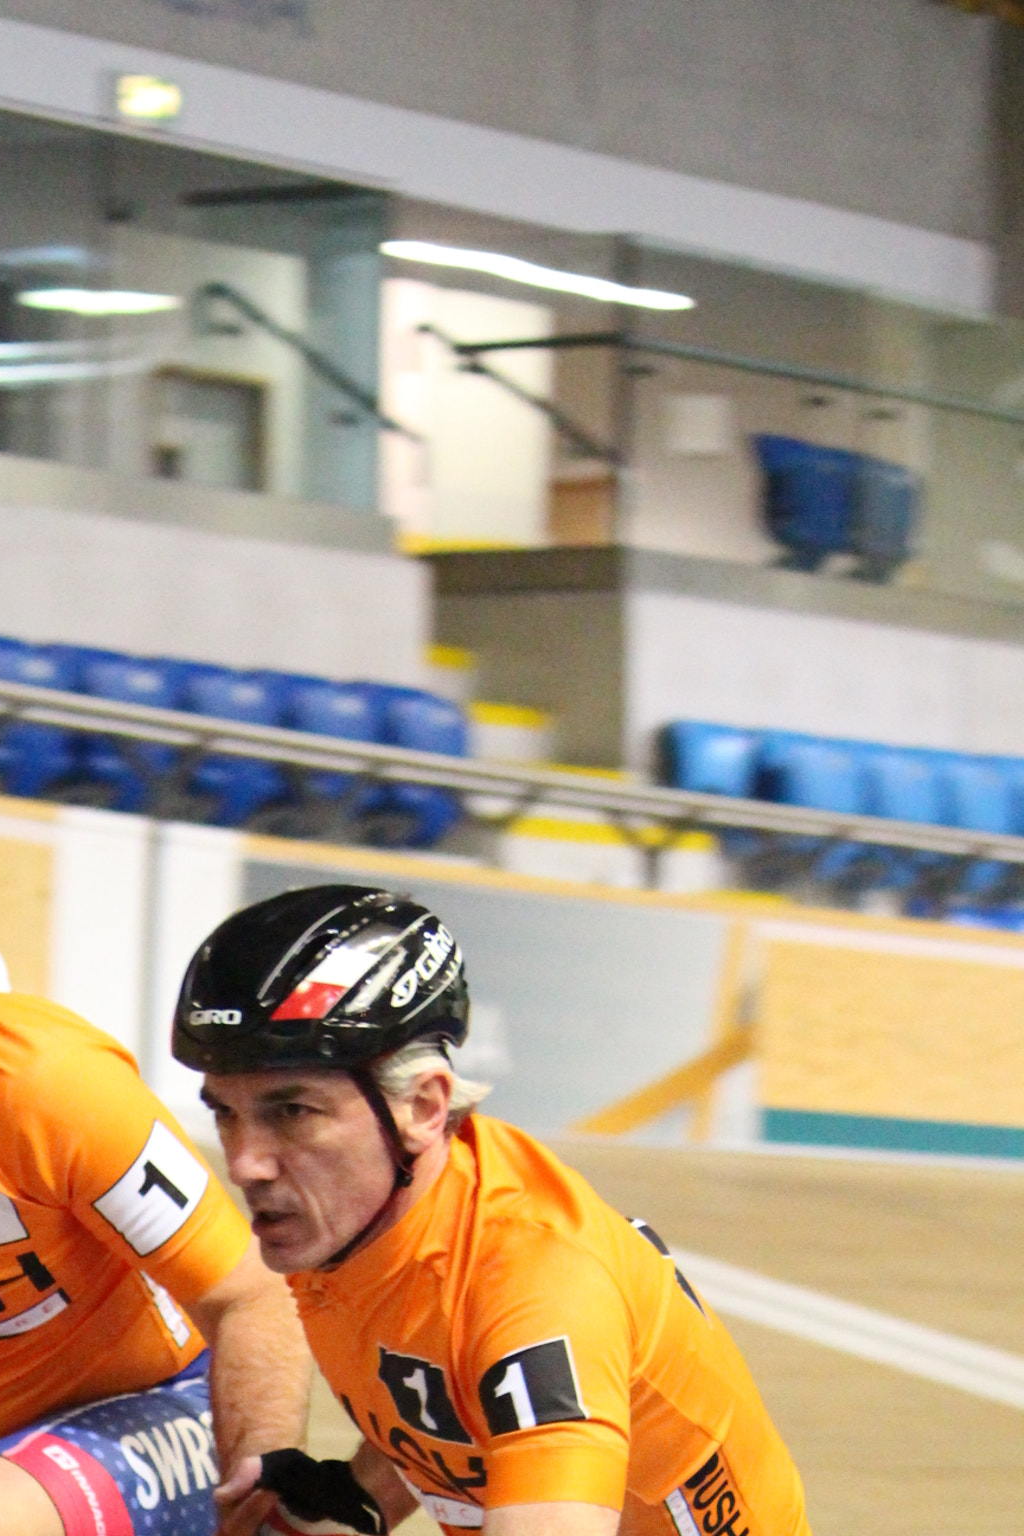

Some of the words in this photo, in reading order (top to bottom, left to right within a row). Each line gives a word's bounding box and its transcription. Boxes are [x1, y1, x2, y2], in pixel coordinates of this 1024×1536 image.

[137, 1160, 189, 1210] 1
[403, 1368, 438, 1430] 1
[494, 1361, 537, 1430] 1
